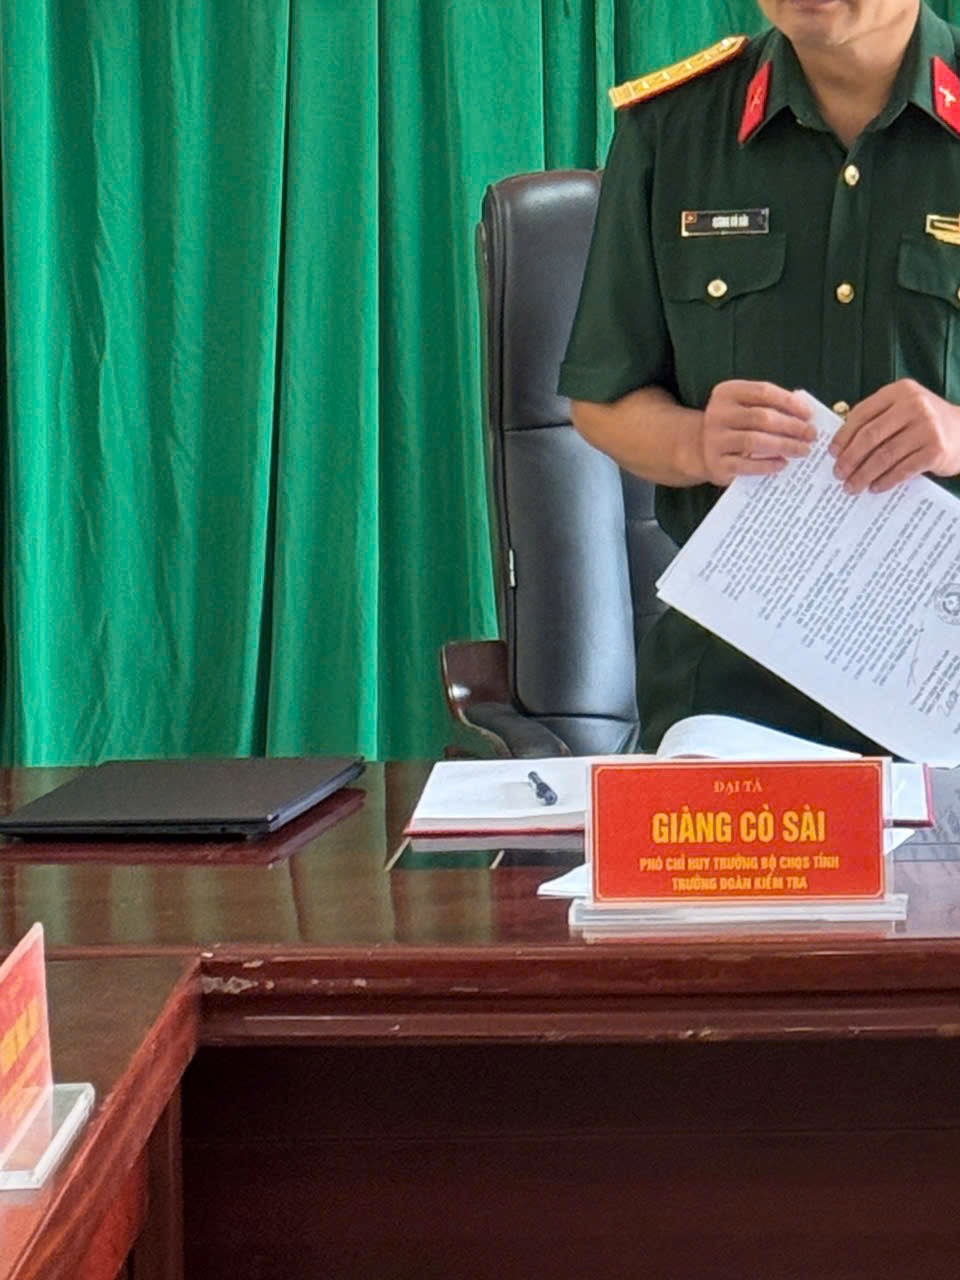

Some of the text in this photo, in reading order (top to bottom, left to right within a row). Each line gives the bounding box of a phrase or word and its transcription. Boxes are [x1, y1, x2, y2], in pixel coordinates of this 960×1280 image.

[687, 857, 711, 871] HUY
[779, 856, 810, 870] CHQS
[786, 876, 808, 890] TRA
